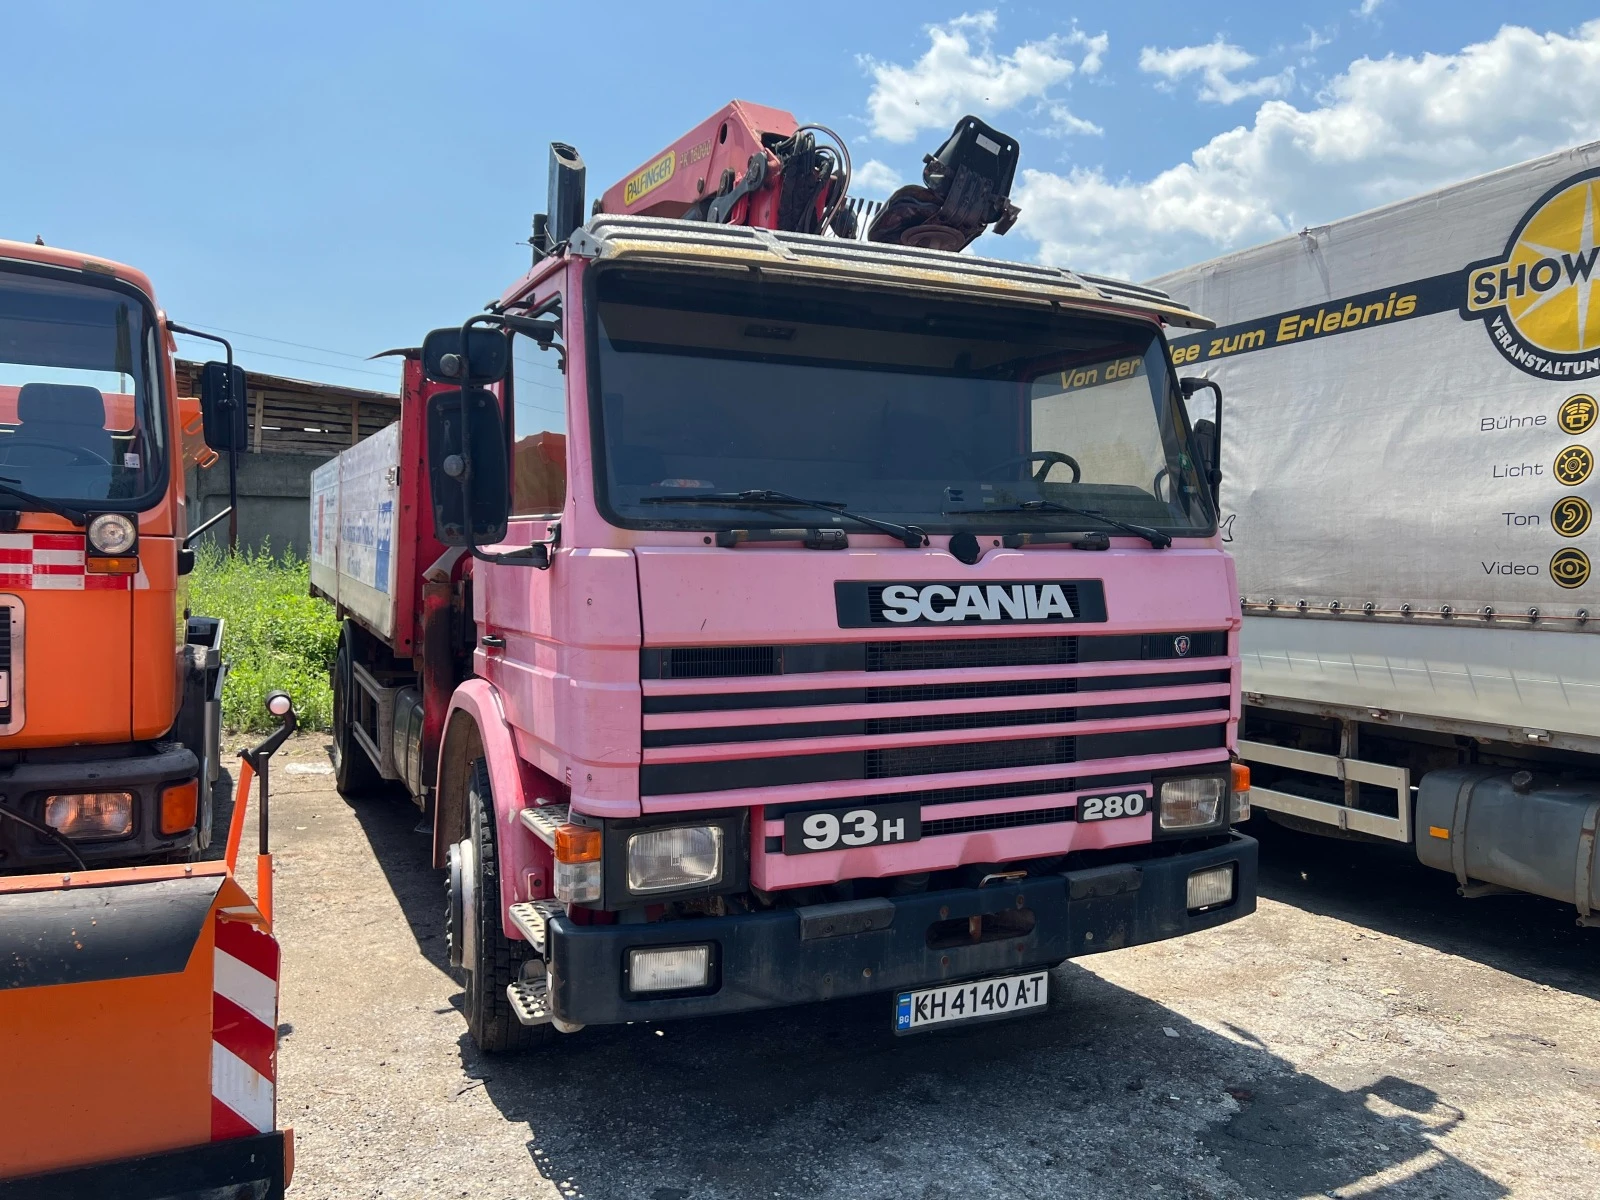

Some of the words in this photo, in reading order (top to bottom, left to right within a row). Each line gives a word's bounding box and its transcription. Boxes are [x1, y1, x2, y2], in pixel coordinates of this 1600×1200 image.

[626, 156, 672, 202] PALFINGER
[1473, 246, 1600, 305] SHOW
[1061, 368, 1098, 390] Von
[1105, 359, 1140, 380] der
[1168, 344, 1201, 365] ee
[1208, 328, 1265, 357] zum
[1275, 291, 1418, 342] Erlebnis
[1491, 314, 1600, 375] VERANSTALTUN
[1480, 414, 1547, 432] Bühne
[1492, 462, 1544, 478] Licht
[1501, 512, 1540, 526] Ton
[1481, 561, 1540, 576] Video
[881, 584, 1075, 623] SCANIA
[1083, 793, 1145, 821] 280
[899, 1015, 910, 1025] BG
